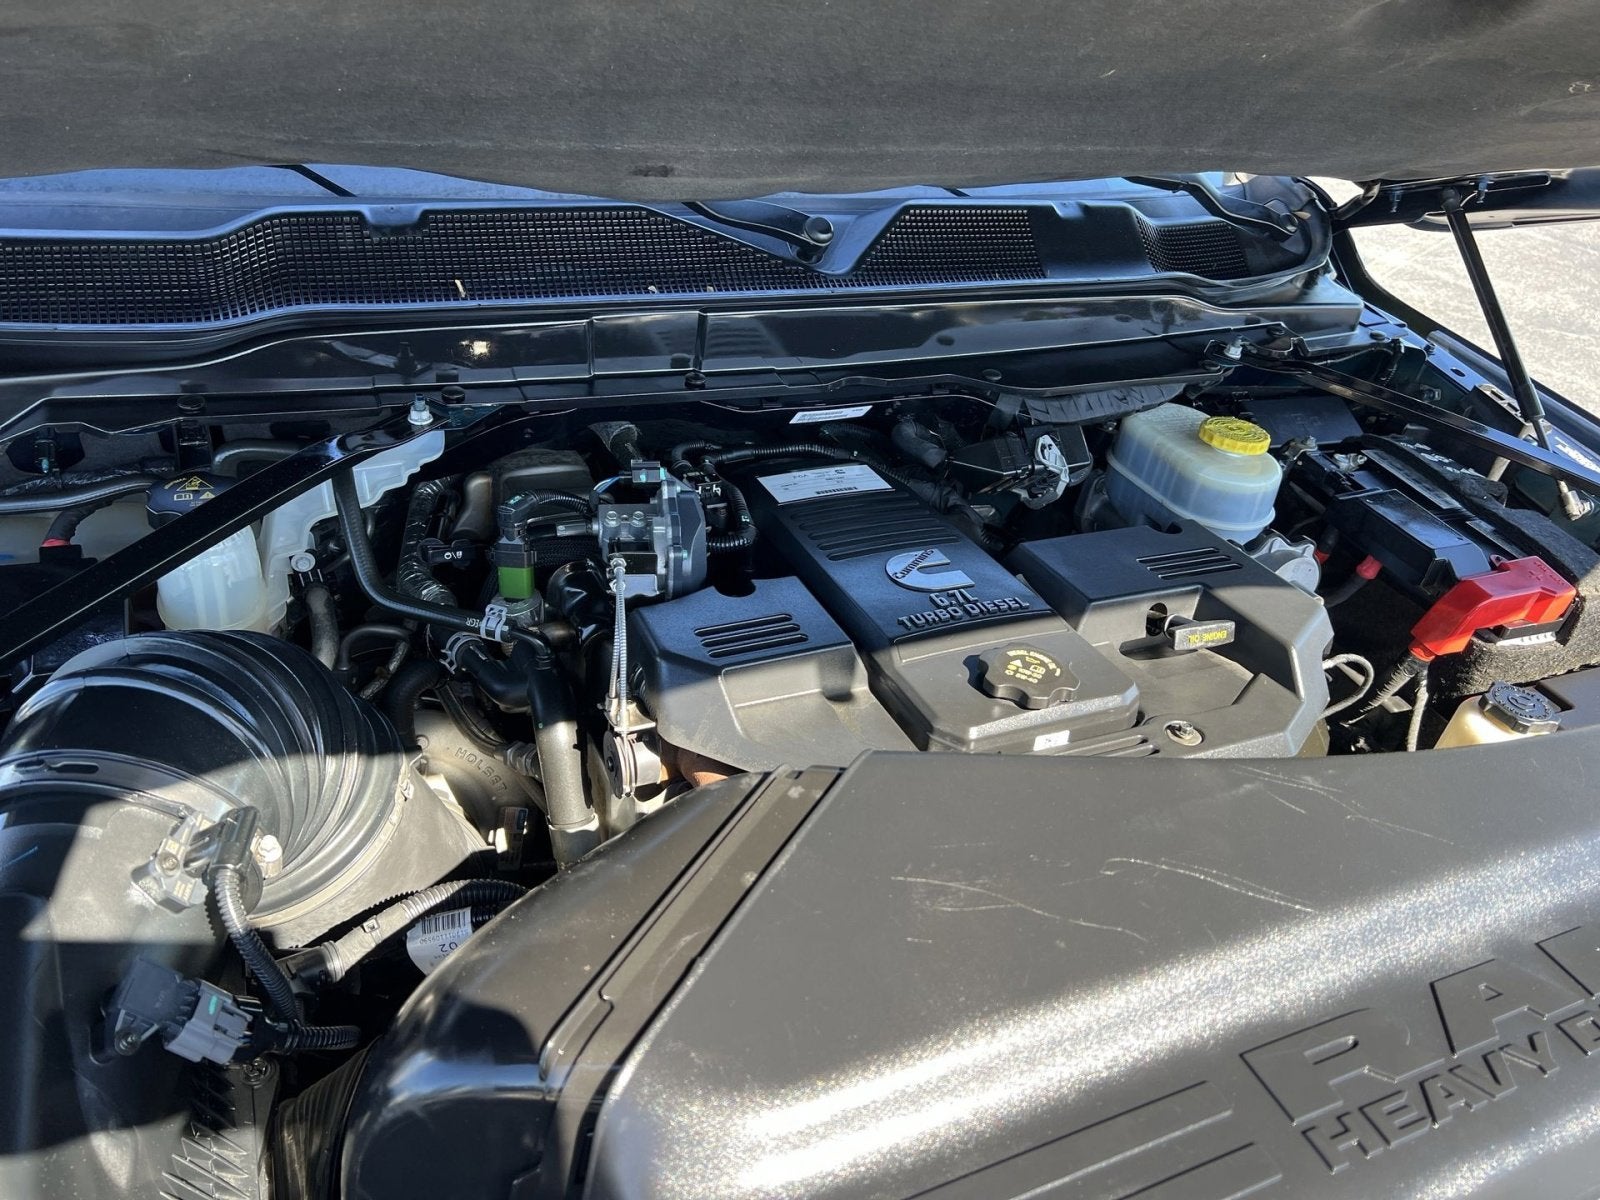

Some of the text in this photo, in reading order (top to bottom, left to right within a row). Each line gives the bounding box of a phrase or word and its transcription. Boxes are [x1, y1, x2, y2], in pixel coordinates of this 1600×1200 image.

[893, 548, 935, 580] Cummins
[897, 596, 1030, 631] TURBO DIESEL
[929, 588, 978, 609] 6.7L
[1187, 629, 1228, 644] ENGINE OIL
[455, 746, 507, 791] HOLSET
[1301, 1030, 1560, 1174] HEAVY
